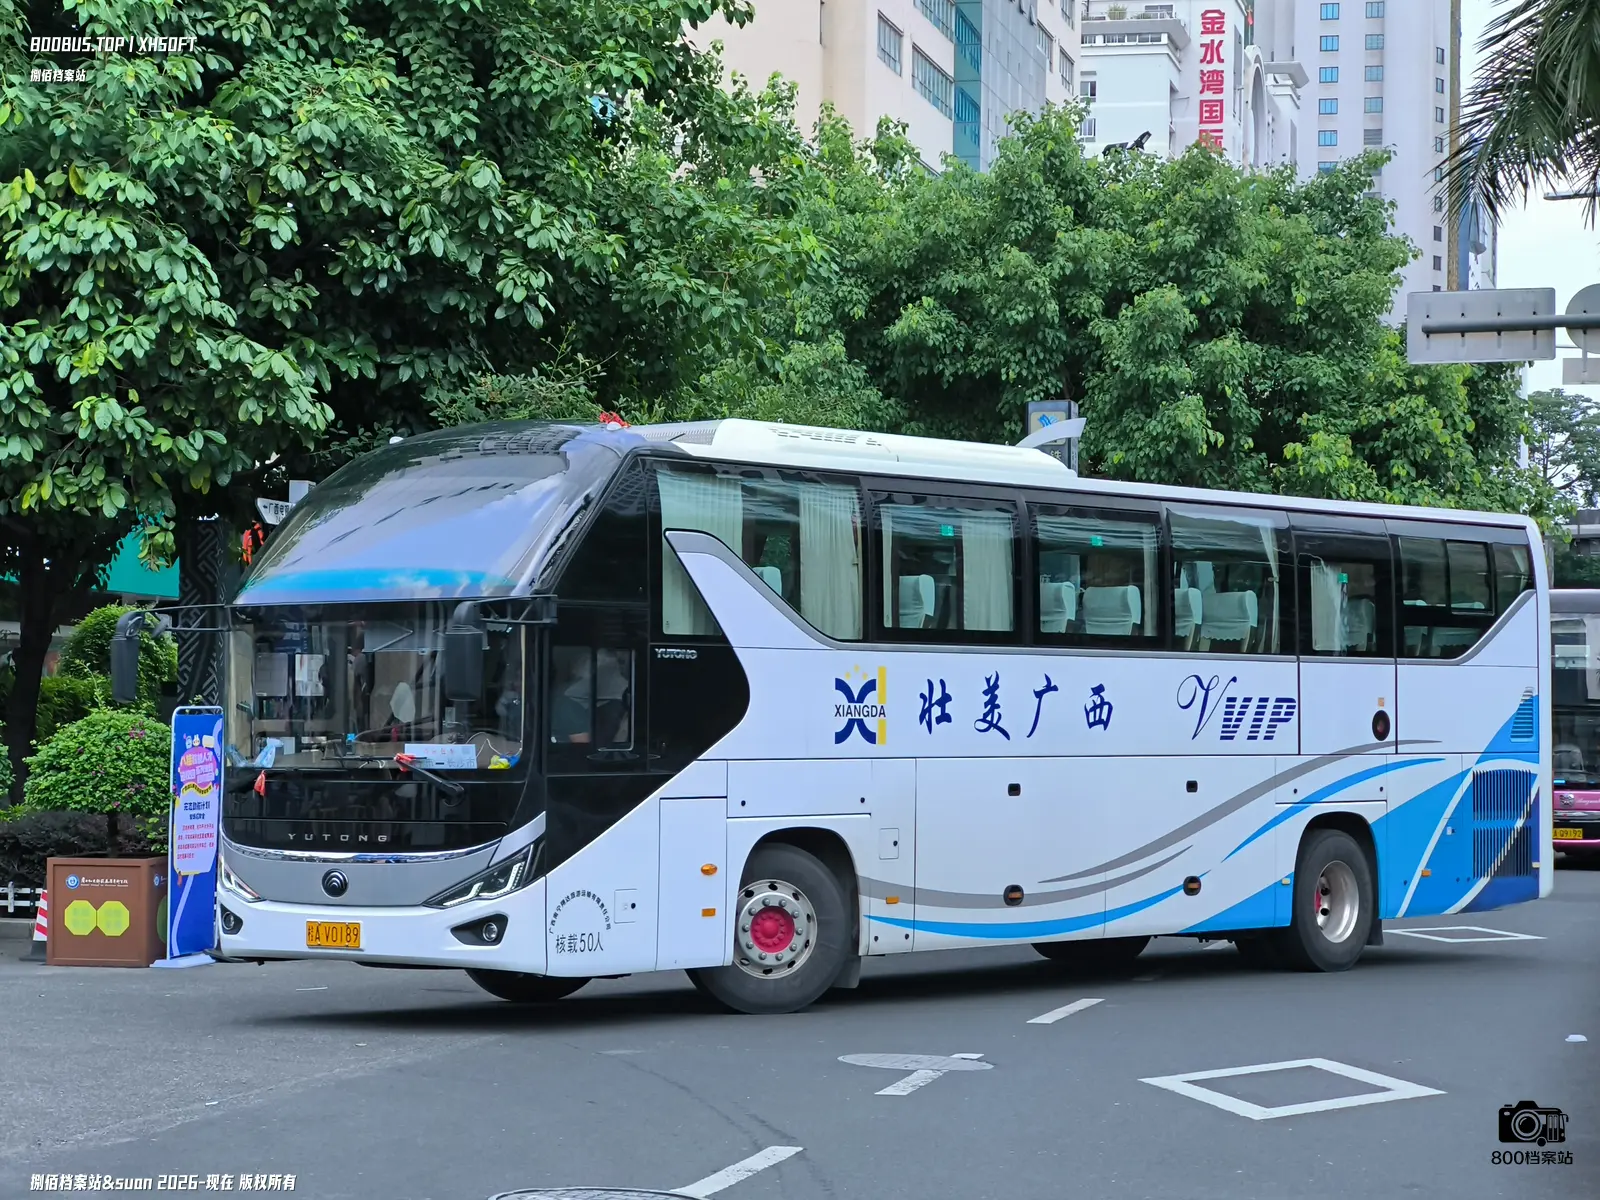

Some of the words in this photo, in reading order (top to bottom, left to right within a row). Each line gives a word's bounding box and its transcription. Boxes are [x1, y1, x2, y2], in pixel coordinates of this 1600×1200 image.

[654, 648, 698, 660] YUTONG
[834, 704, 887, 718] XIANGDA
[918, 670, 1114, 741] 壮美广西
[288, 833, 388, 842] YUTONG
[555, 931, 604, 954] 核载50人
